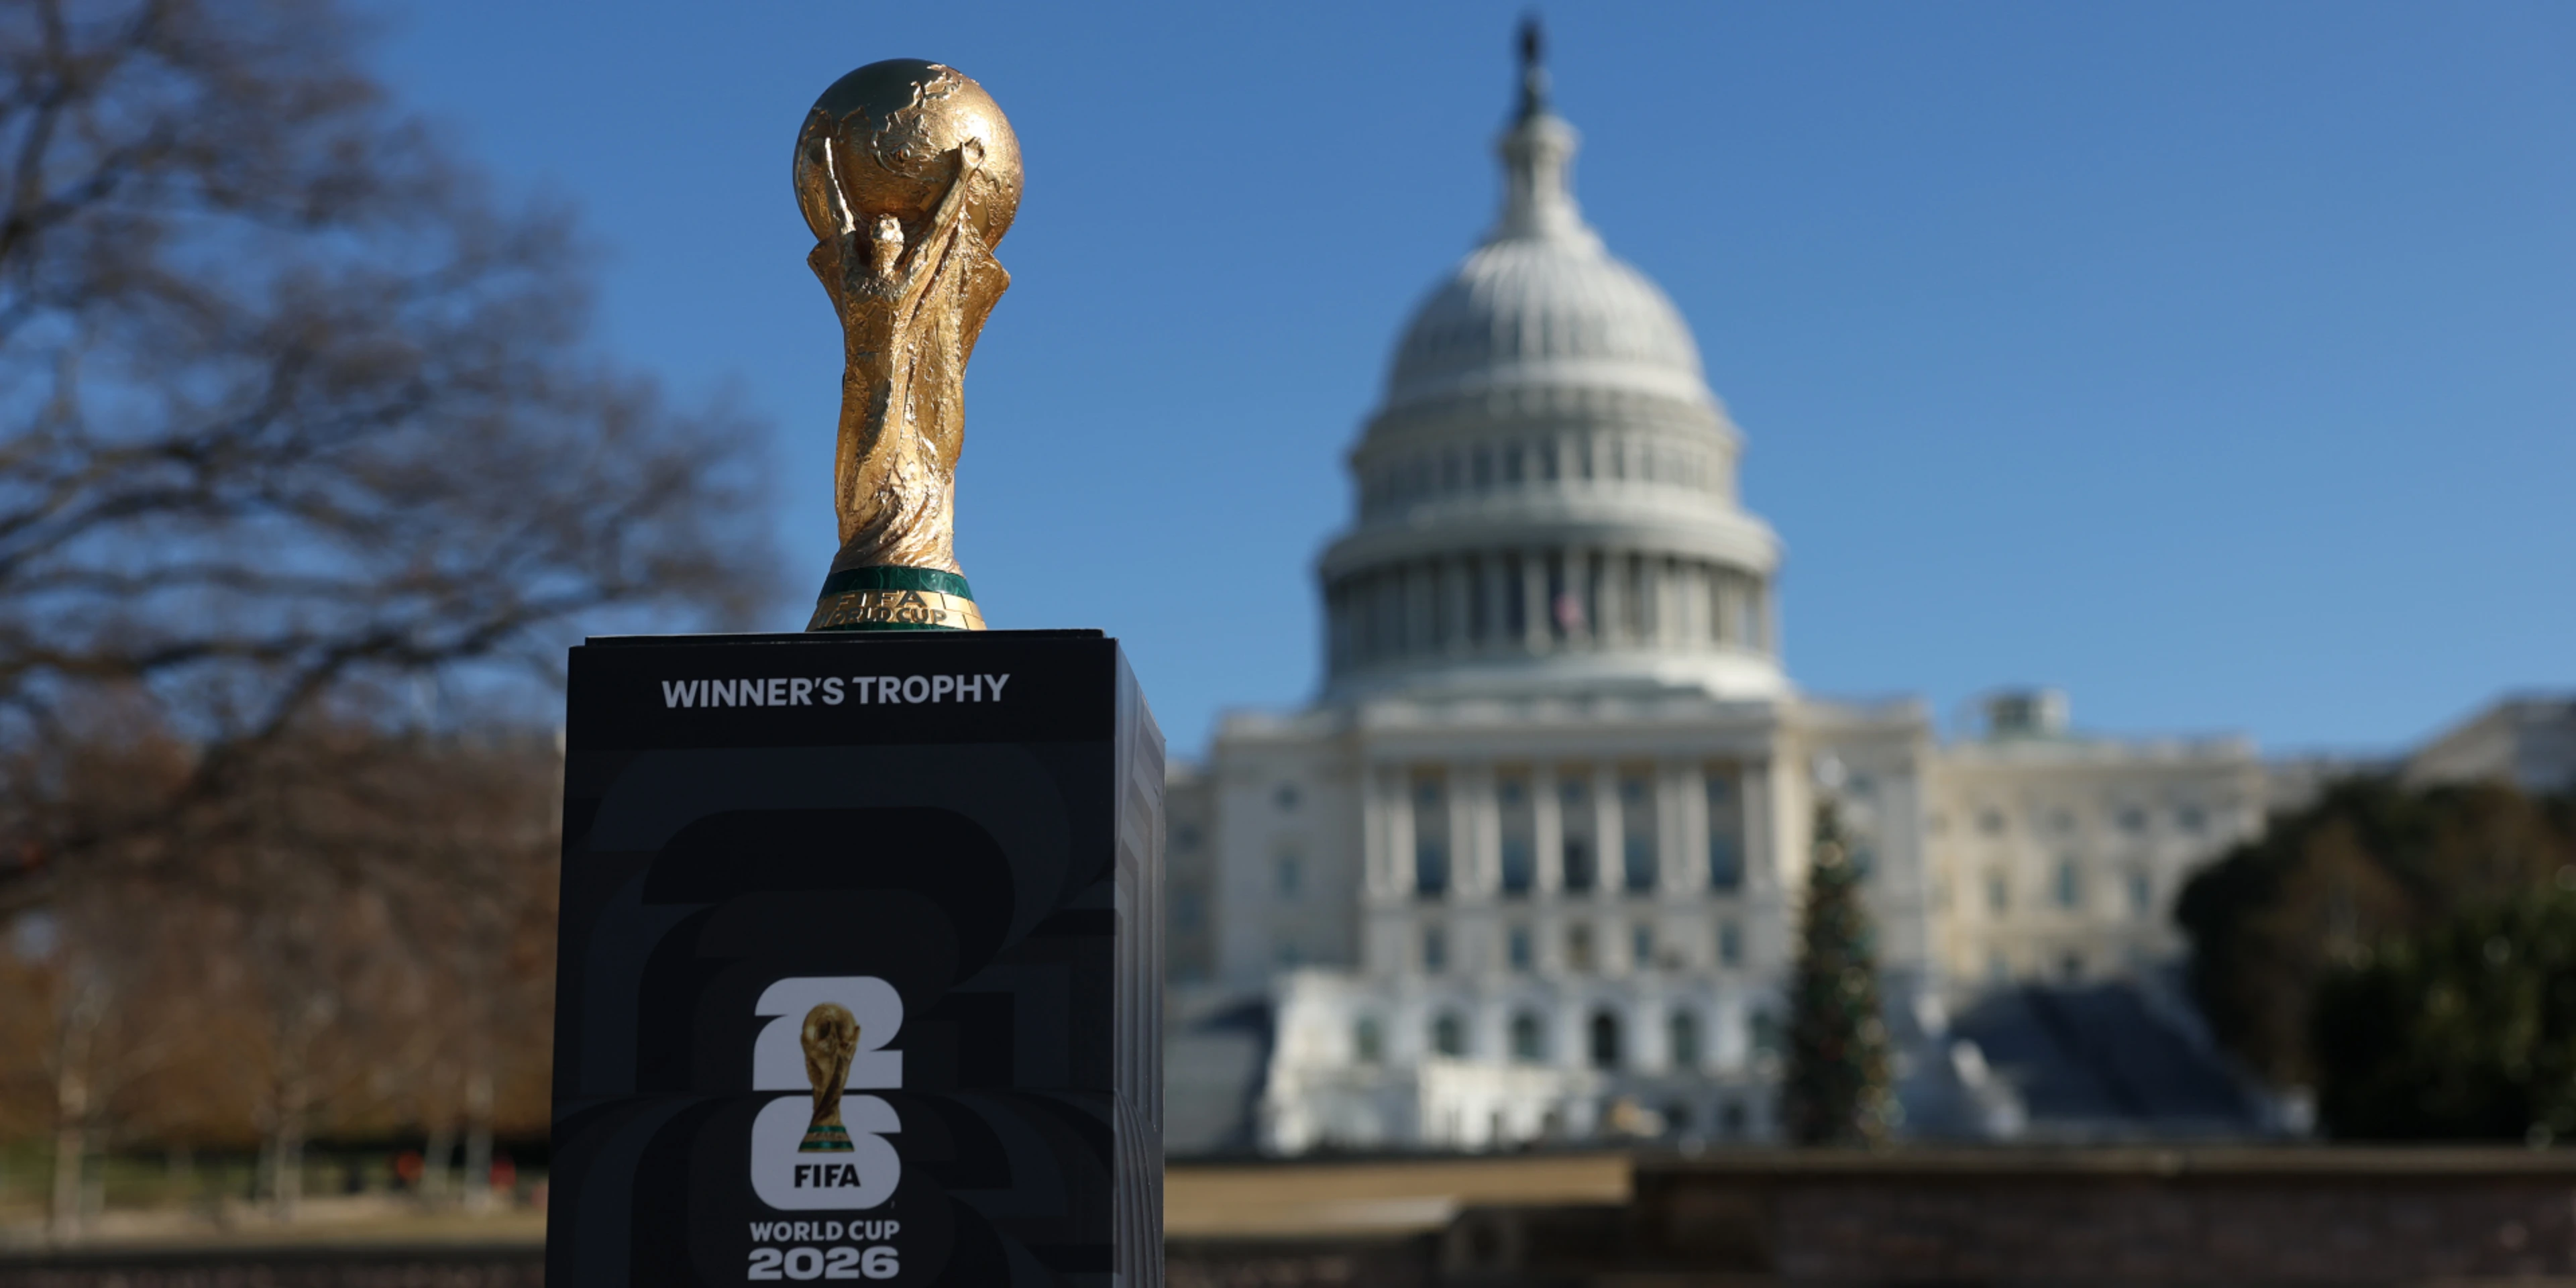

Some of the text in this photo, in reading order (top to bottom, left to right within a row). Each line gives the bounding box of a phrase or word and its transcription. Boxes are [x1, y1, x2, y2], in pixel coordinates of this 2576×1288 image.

[837, 590, 927, 607] FIFA
[814, 606, 947, 627] WORLD CUP
[662, 674, 1010, 708] WINNER'S TROPHY
[794, 1164, 861, 1188] FIFA
[749, 1220, 900, 1242] WORLD CUP
[747, 1246, 900, 1280] 2026
